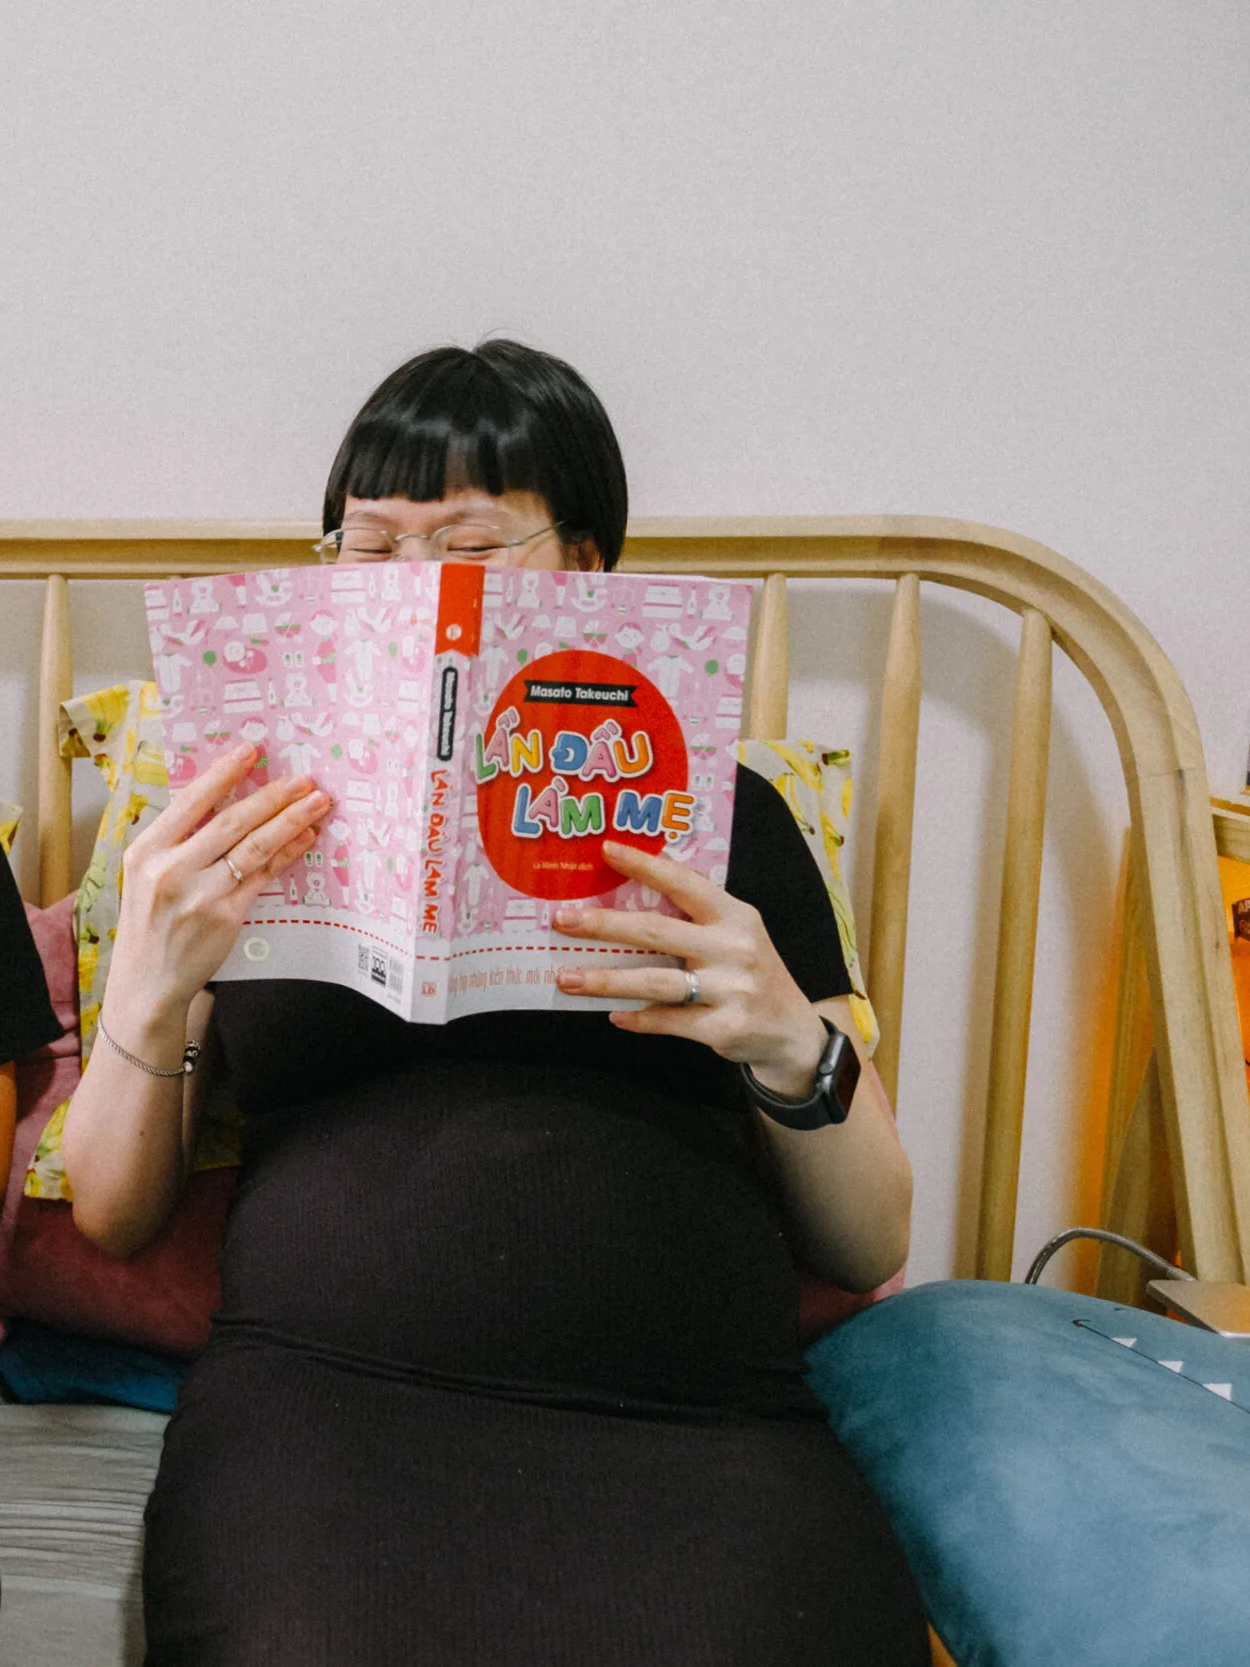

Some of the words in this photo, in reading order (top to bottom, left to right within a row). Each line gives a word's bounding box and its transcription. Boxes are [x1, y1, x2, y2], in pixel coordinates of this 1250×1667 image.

[530, 685, 572, 698] Masato
[575, 687, 629, 701] Takeuchi
[475, 708, 541, 782] LẦN
[551, 720, 652, 781] ĐẦU
[513, 777, 604, 838] LÀM
[614, 791, 695, 841] MẸ
